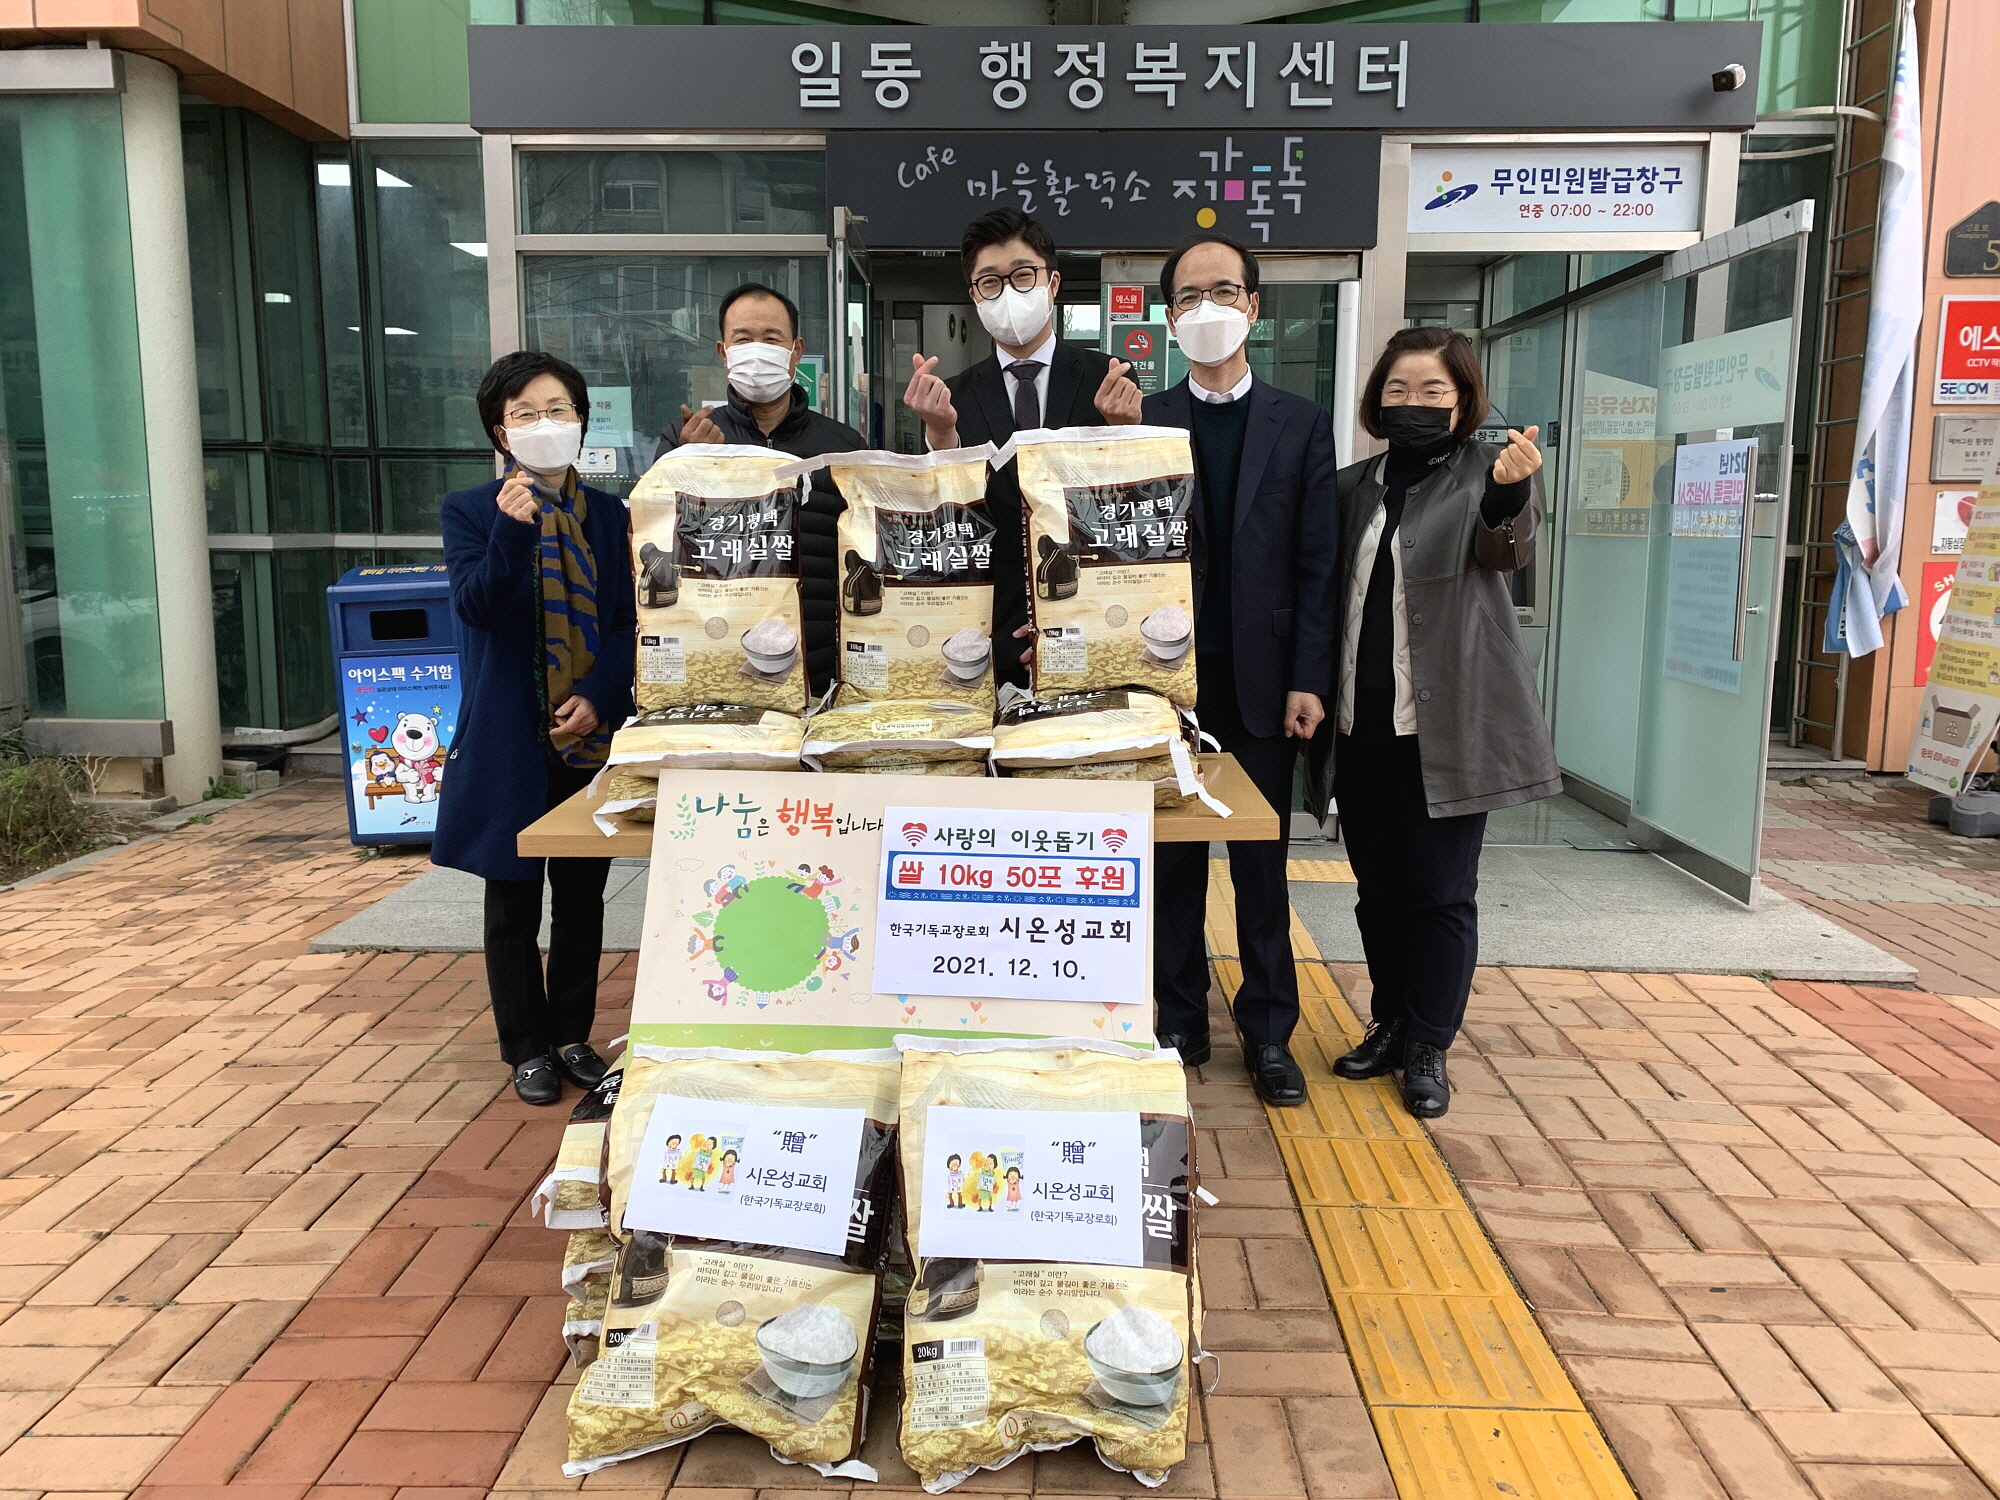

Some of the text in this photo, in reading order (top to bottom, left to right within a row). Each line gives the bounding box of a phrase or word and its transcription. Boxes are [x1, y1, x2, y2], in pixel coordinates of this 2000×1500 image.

[790, 39, 1410, 110] 일동 행정복지센터
[896, 145, 958, 188] Cafe
[967, 159, 1151, 216] 마을활력소
[1490, 166, 1683, 195] 무인민원발급창구
[1519, 204, 1544, 219] 연중
[1550, 204, 1592, 217] 07:00
[1613, 203, 1654, 217] 22:00
[1966, 358, 1991, 368] CCTV
[1940, 382, 1989, 395] SECOM
[1099, 495, 1174, 520] 경기평택
[708, 509, 779, 532] 경기평택
[907, 521, 975, 545] 경기평택
[1087, 520, 1189, 549] 고래실쌀
[691, 534, 795, 564] 고래실쌀
[893, 543, 993, 572] 고래실쌀
[347, 664, 454, 684] 아이스팩 수거함
[695, 792, 884, 839] 나눔은 행복입니다
[934, 827, 1095, 852] 사랑의 이웃돕기
[898, 860, 1125, 891] 쌀 10kg 50포 후원
[889, 916, 1132, 945] 한국기독교장로회 시온성교회
[932, 956, 1086, 980] 2021. 12. 10.
[746, 1166, 828, 1193] 시온성교회
[1032, 1182, 1115, 1203] 시온성교회
[740, 1194, 827, 1216] (한국기독교장로회)
[1030, 1210, 1118, 1226] (한국기독교장로회)
[697, 1266, 720, 1276] 바닥이
[723, 1269, 737, 1278] 깊고
[733, 1262, 753, 1271] 이란?
[1047, 1271, 1068, 1279] 이란?
[695, 1275, 785, 1295] 이라는 순수 우리말입니다.
[1013, 1279, 1036, 1287] 바닥이
[1039, 1280, 1053, 1288] 깊고
[1082, 1281, 1097, 1289] 좋은
[1013, 1288, 1103, 1298] 이라는 순수 우리말입니다.
[917, 1346, 937, 1358] 20kg
